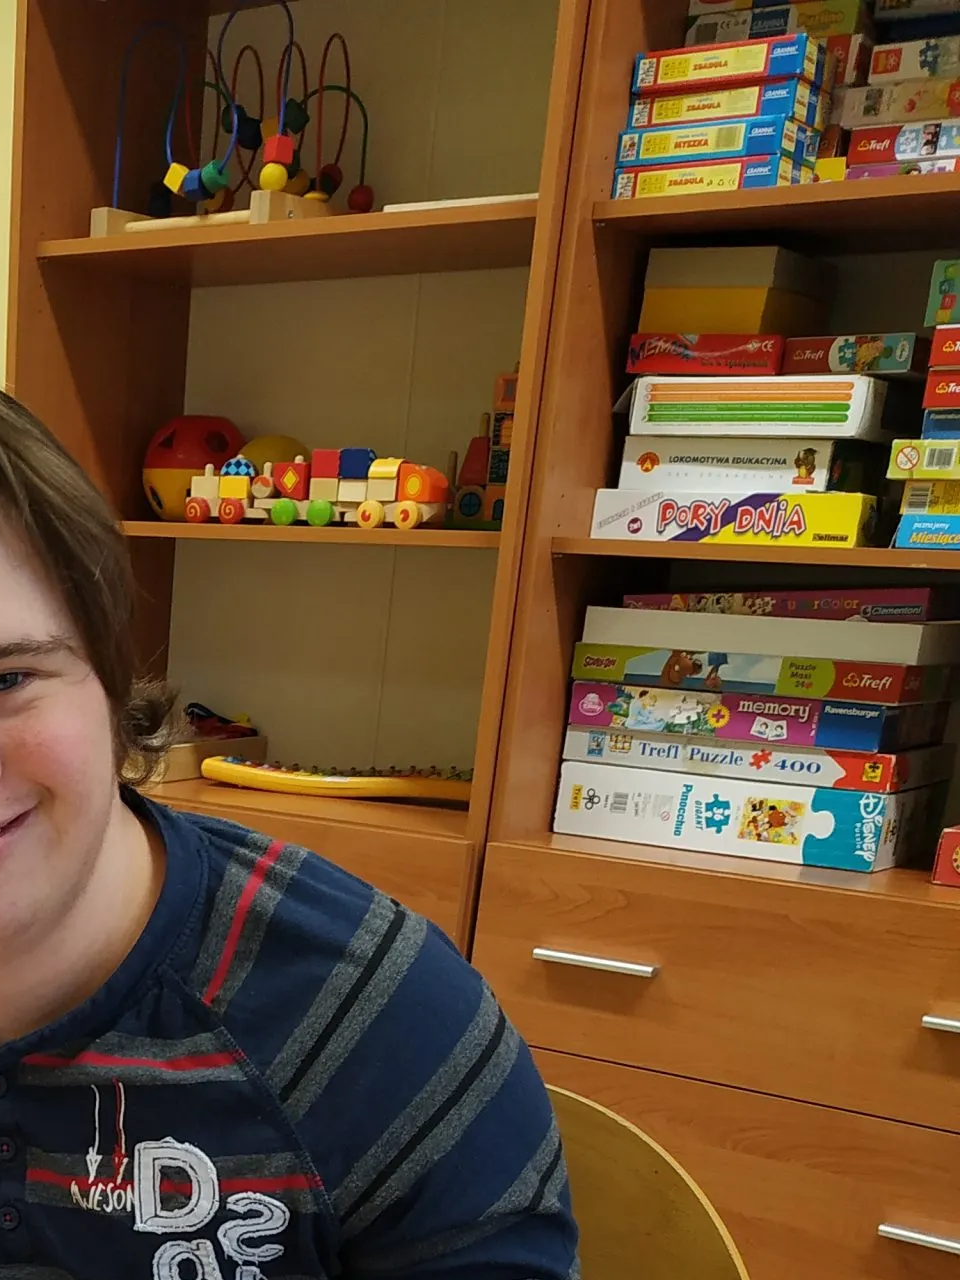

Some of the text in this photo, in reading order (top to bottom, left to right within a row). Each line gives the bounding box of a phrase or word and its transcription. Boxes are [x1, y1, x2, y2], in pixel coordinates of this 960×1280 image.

[668, 455, 787, 467] LOKOMOTYWA EDUKACYJNA
[859, 673, 893, 692] Trefl
[737, 700, 813, 722] memory
[824, 704, 880, 720] Ravensburger
[639, 741, 821, 774] Trefl Puzzle 400
[673, 783, 694, 836] Pinocchio
